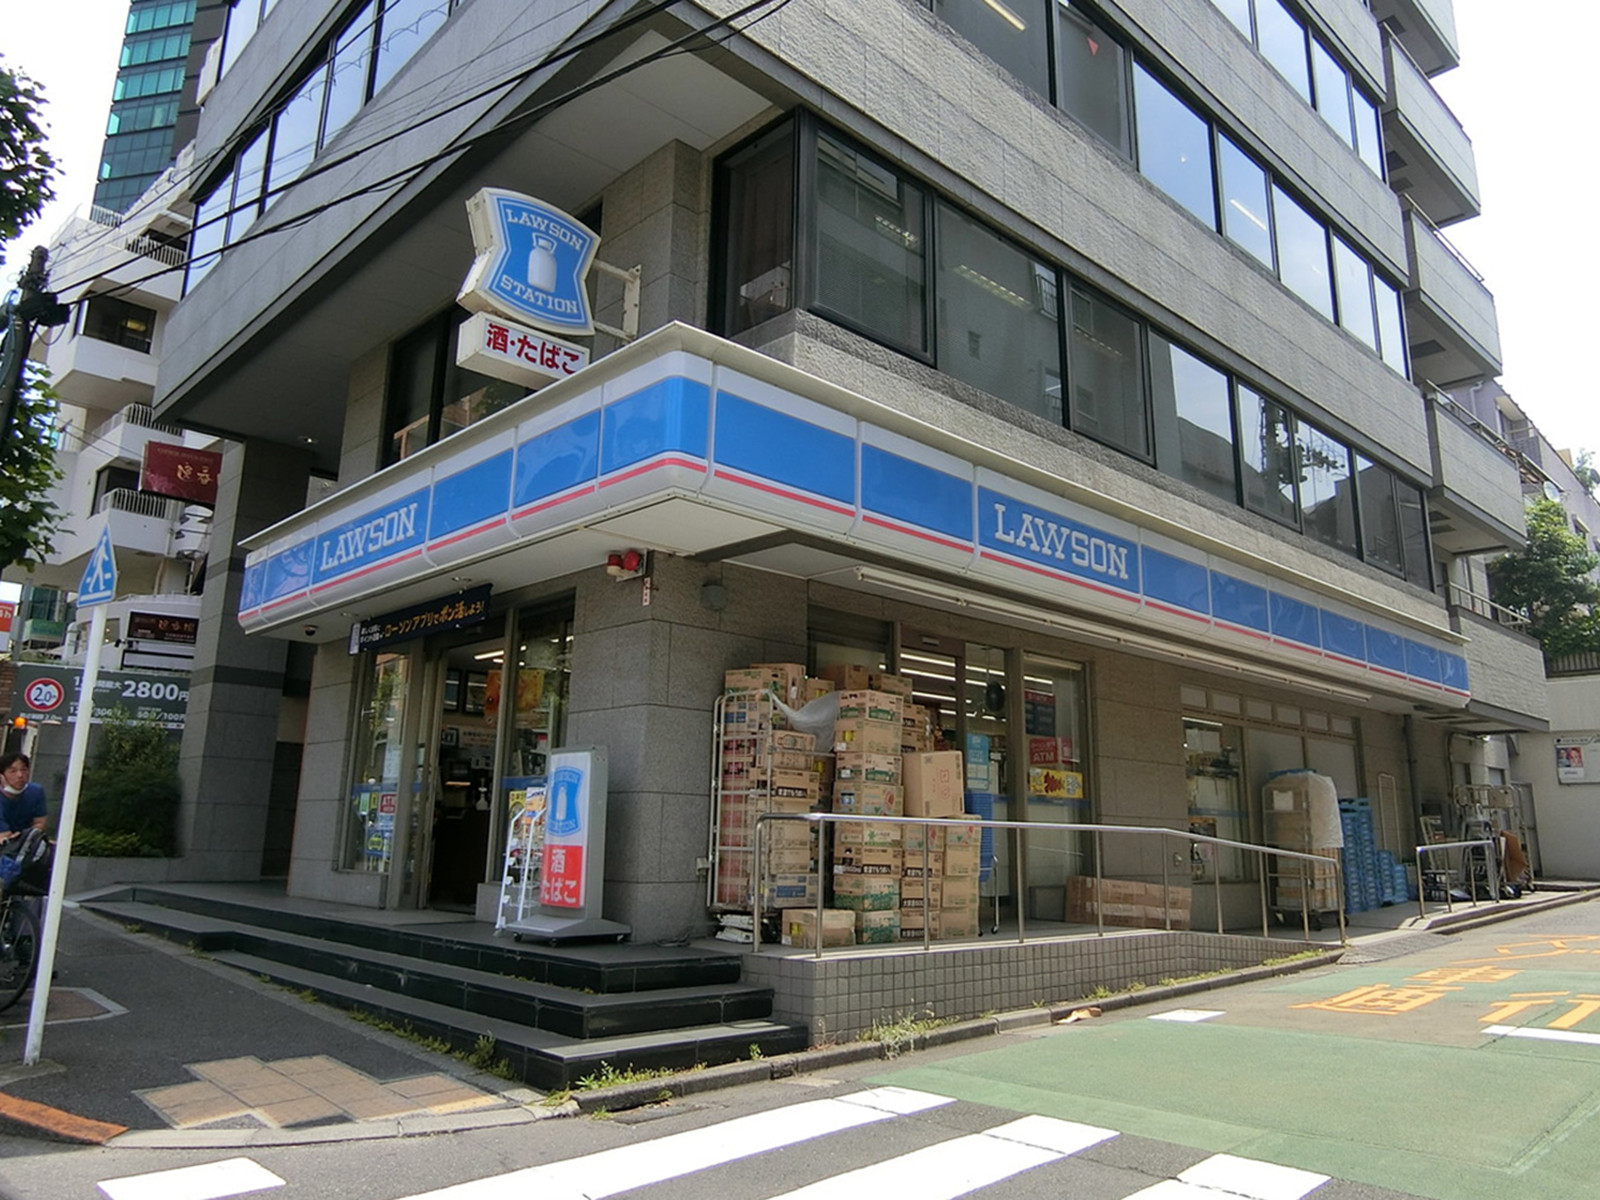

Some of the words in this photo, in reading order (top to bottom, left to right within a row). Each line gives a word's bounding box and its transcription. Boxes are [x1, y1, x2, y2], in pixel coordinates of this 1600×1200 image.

[506, 208, 583, 251] LAWSON
[500, 274, 579, 315] STATION
[486, 323, 580, 375] 酒・たばこ
[320, 502, 418, 571] LAWSON
[994, 503, 1129, 580] LAWSON
[1032, 752, 1055, 762] ATM
[551, 848, 567, 874] 酒
[540, 877, 577, 904] たばこ
